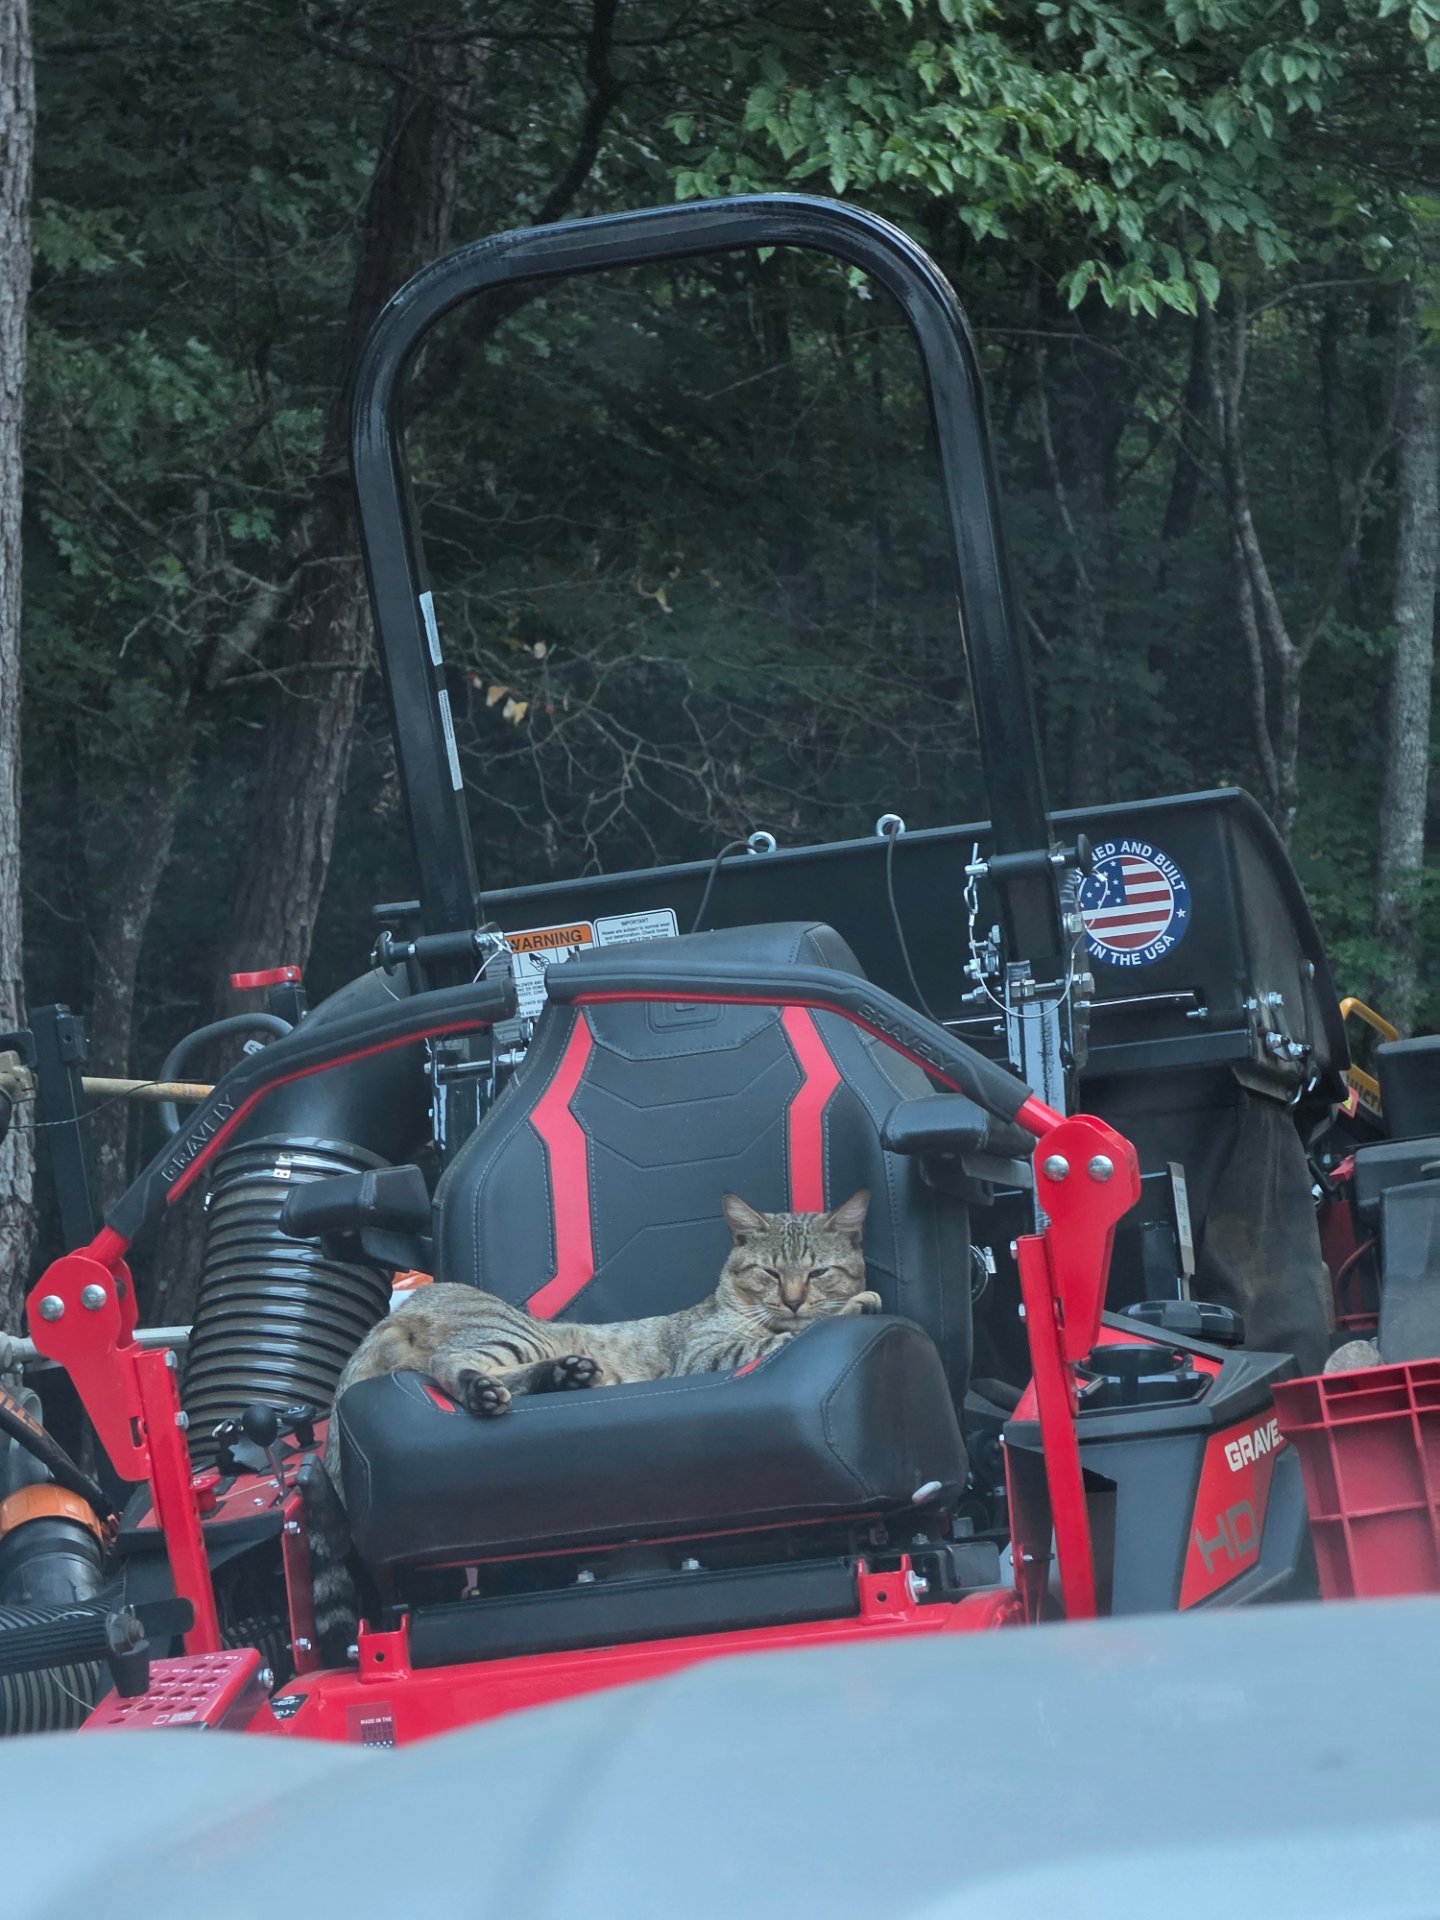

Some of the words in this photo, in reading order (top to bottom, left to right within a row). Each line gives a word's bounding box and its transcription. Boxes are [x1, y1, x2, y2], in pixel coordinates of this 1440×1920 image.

[1121, 841, 1152, 857] AND
[1153, 853, 1186, 891] BUILT
[511, 929, 583, 950] WARNING
[621, 917, 649, 926] IMPORTANT
[1089, 942, 1107, 959] IN
[1110, 951, 1142, 966] THE
[1144, 935, 1175, 960] USA
[857, 1003, 956, 1071] GRAVELY
[161, 1093, 235, 1182] GRAVELY
[1224, 1417, 1284, 1473] GRAVE
[1194, 1499, 1259, 1574] HD
